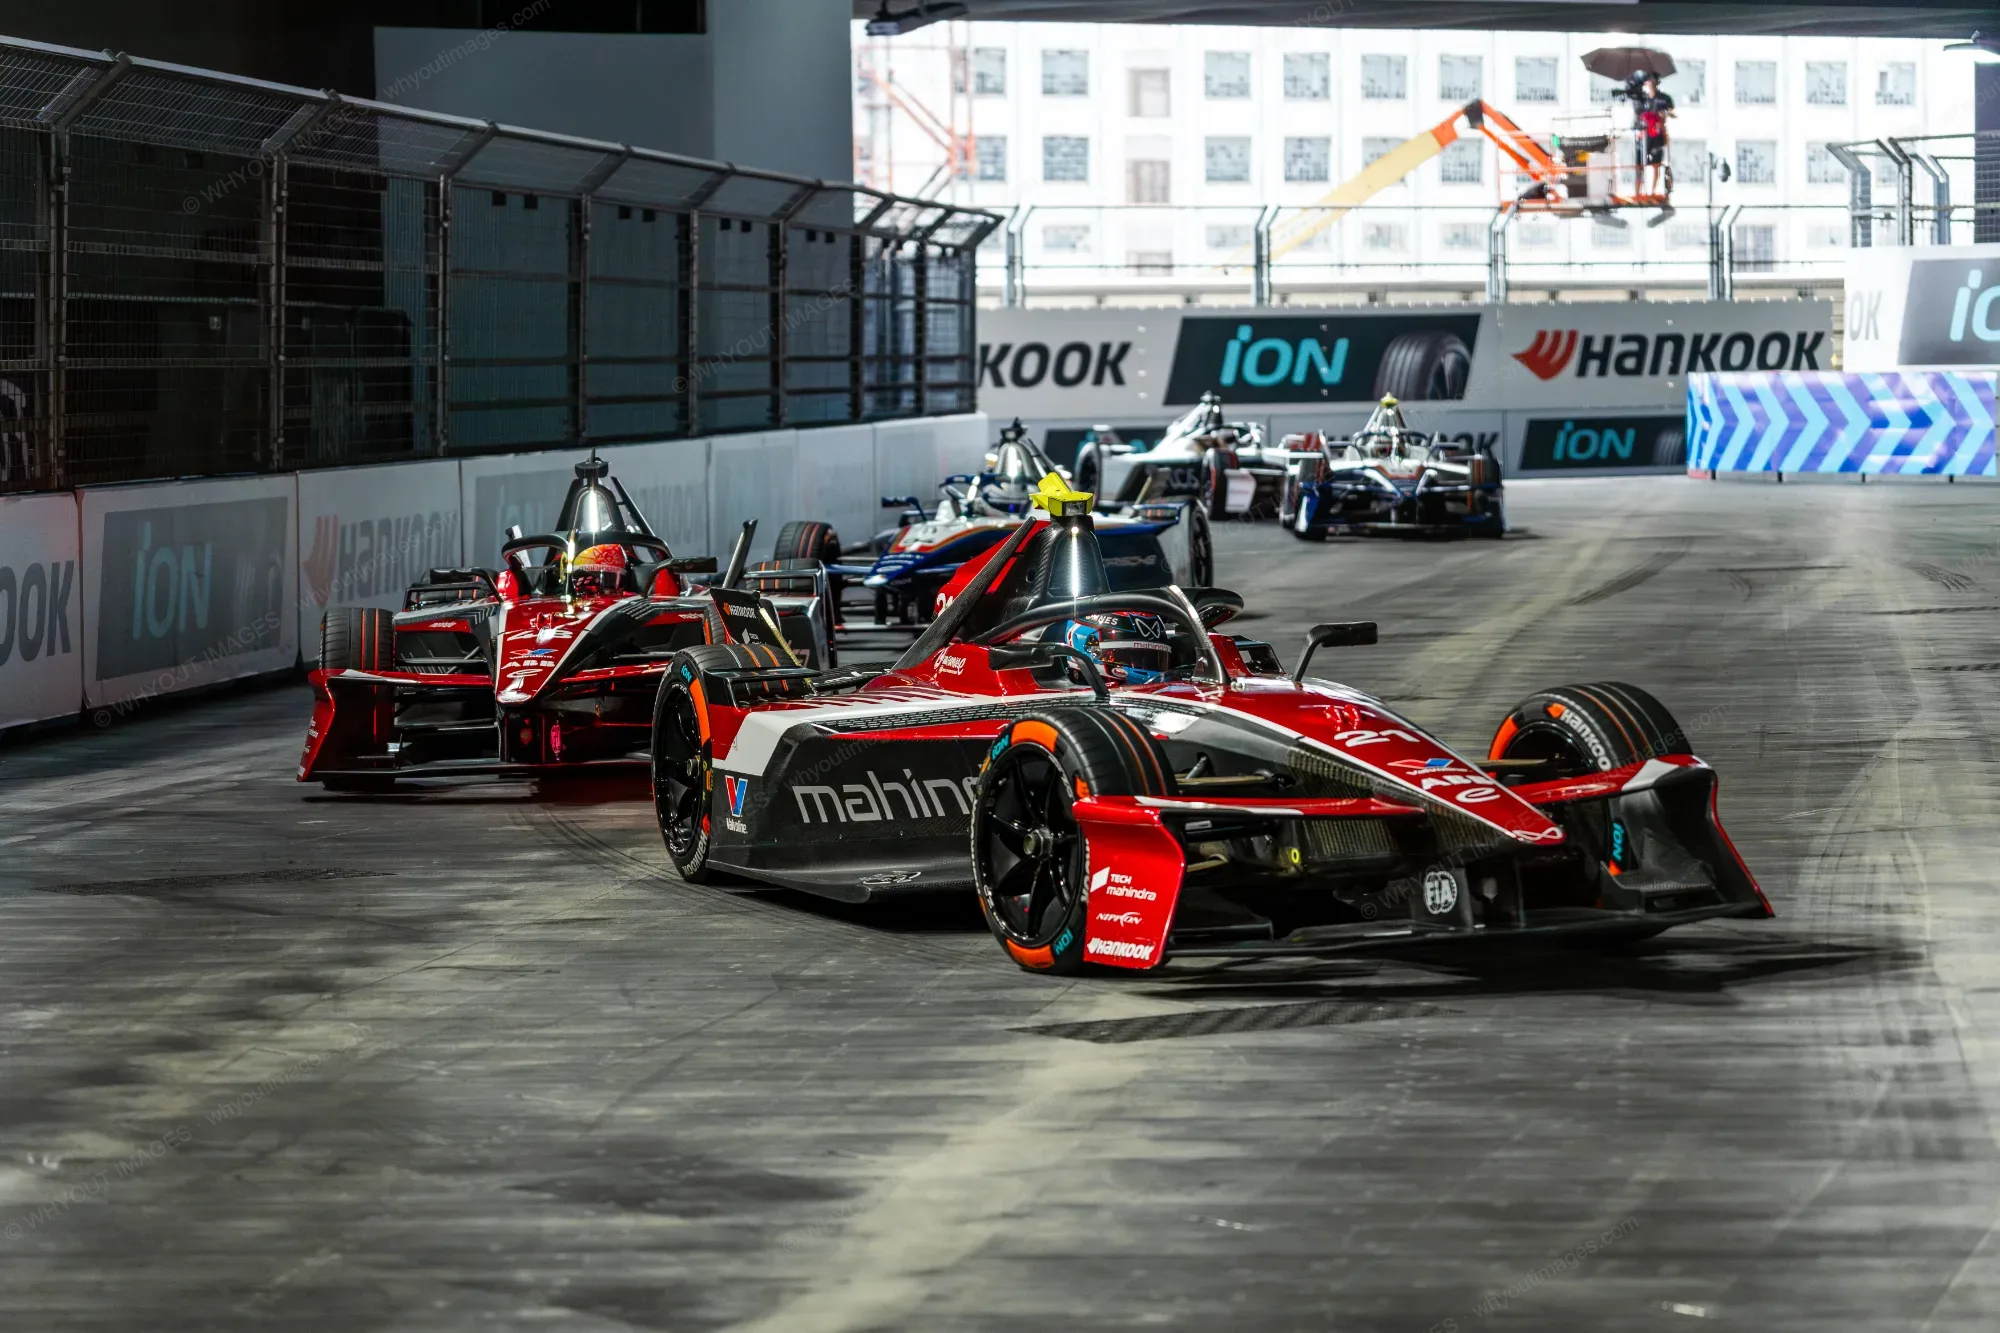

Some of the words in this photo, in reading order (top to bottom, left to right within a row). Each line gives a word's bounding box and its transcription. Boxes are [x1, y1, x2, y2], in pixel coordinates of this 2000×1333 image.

[977, 341, 1133, 388] KOOK
[1560, 708, 1612, 771] HANKOO
[792, 769, 980, 823] mahin
[1106, 886, 1157, 901] mahindra
[1110, 874, 1132, 884] TECH
